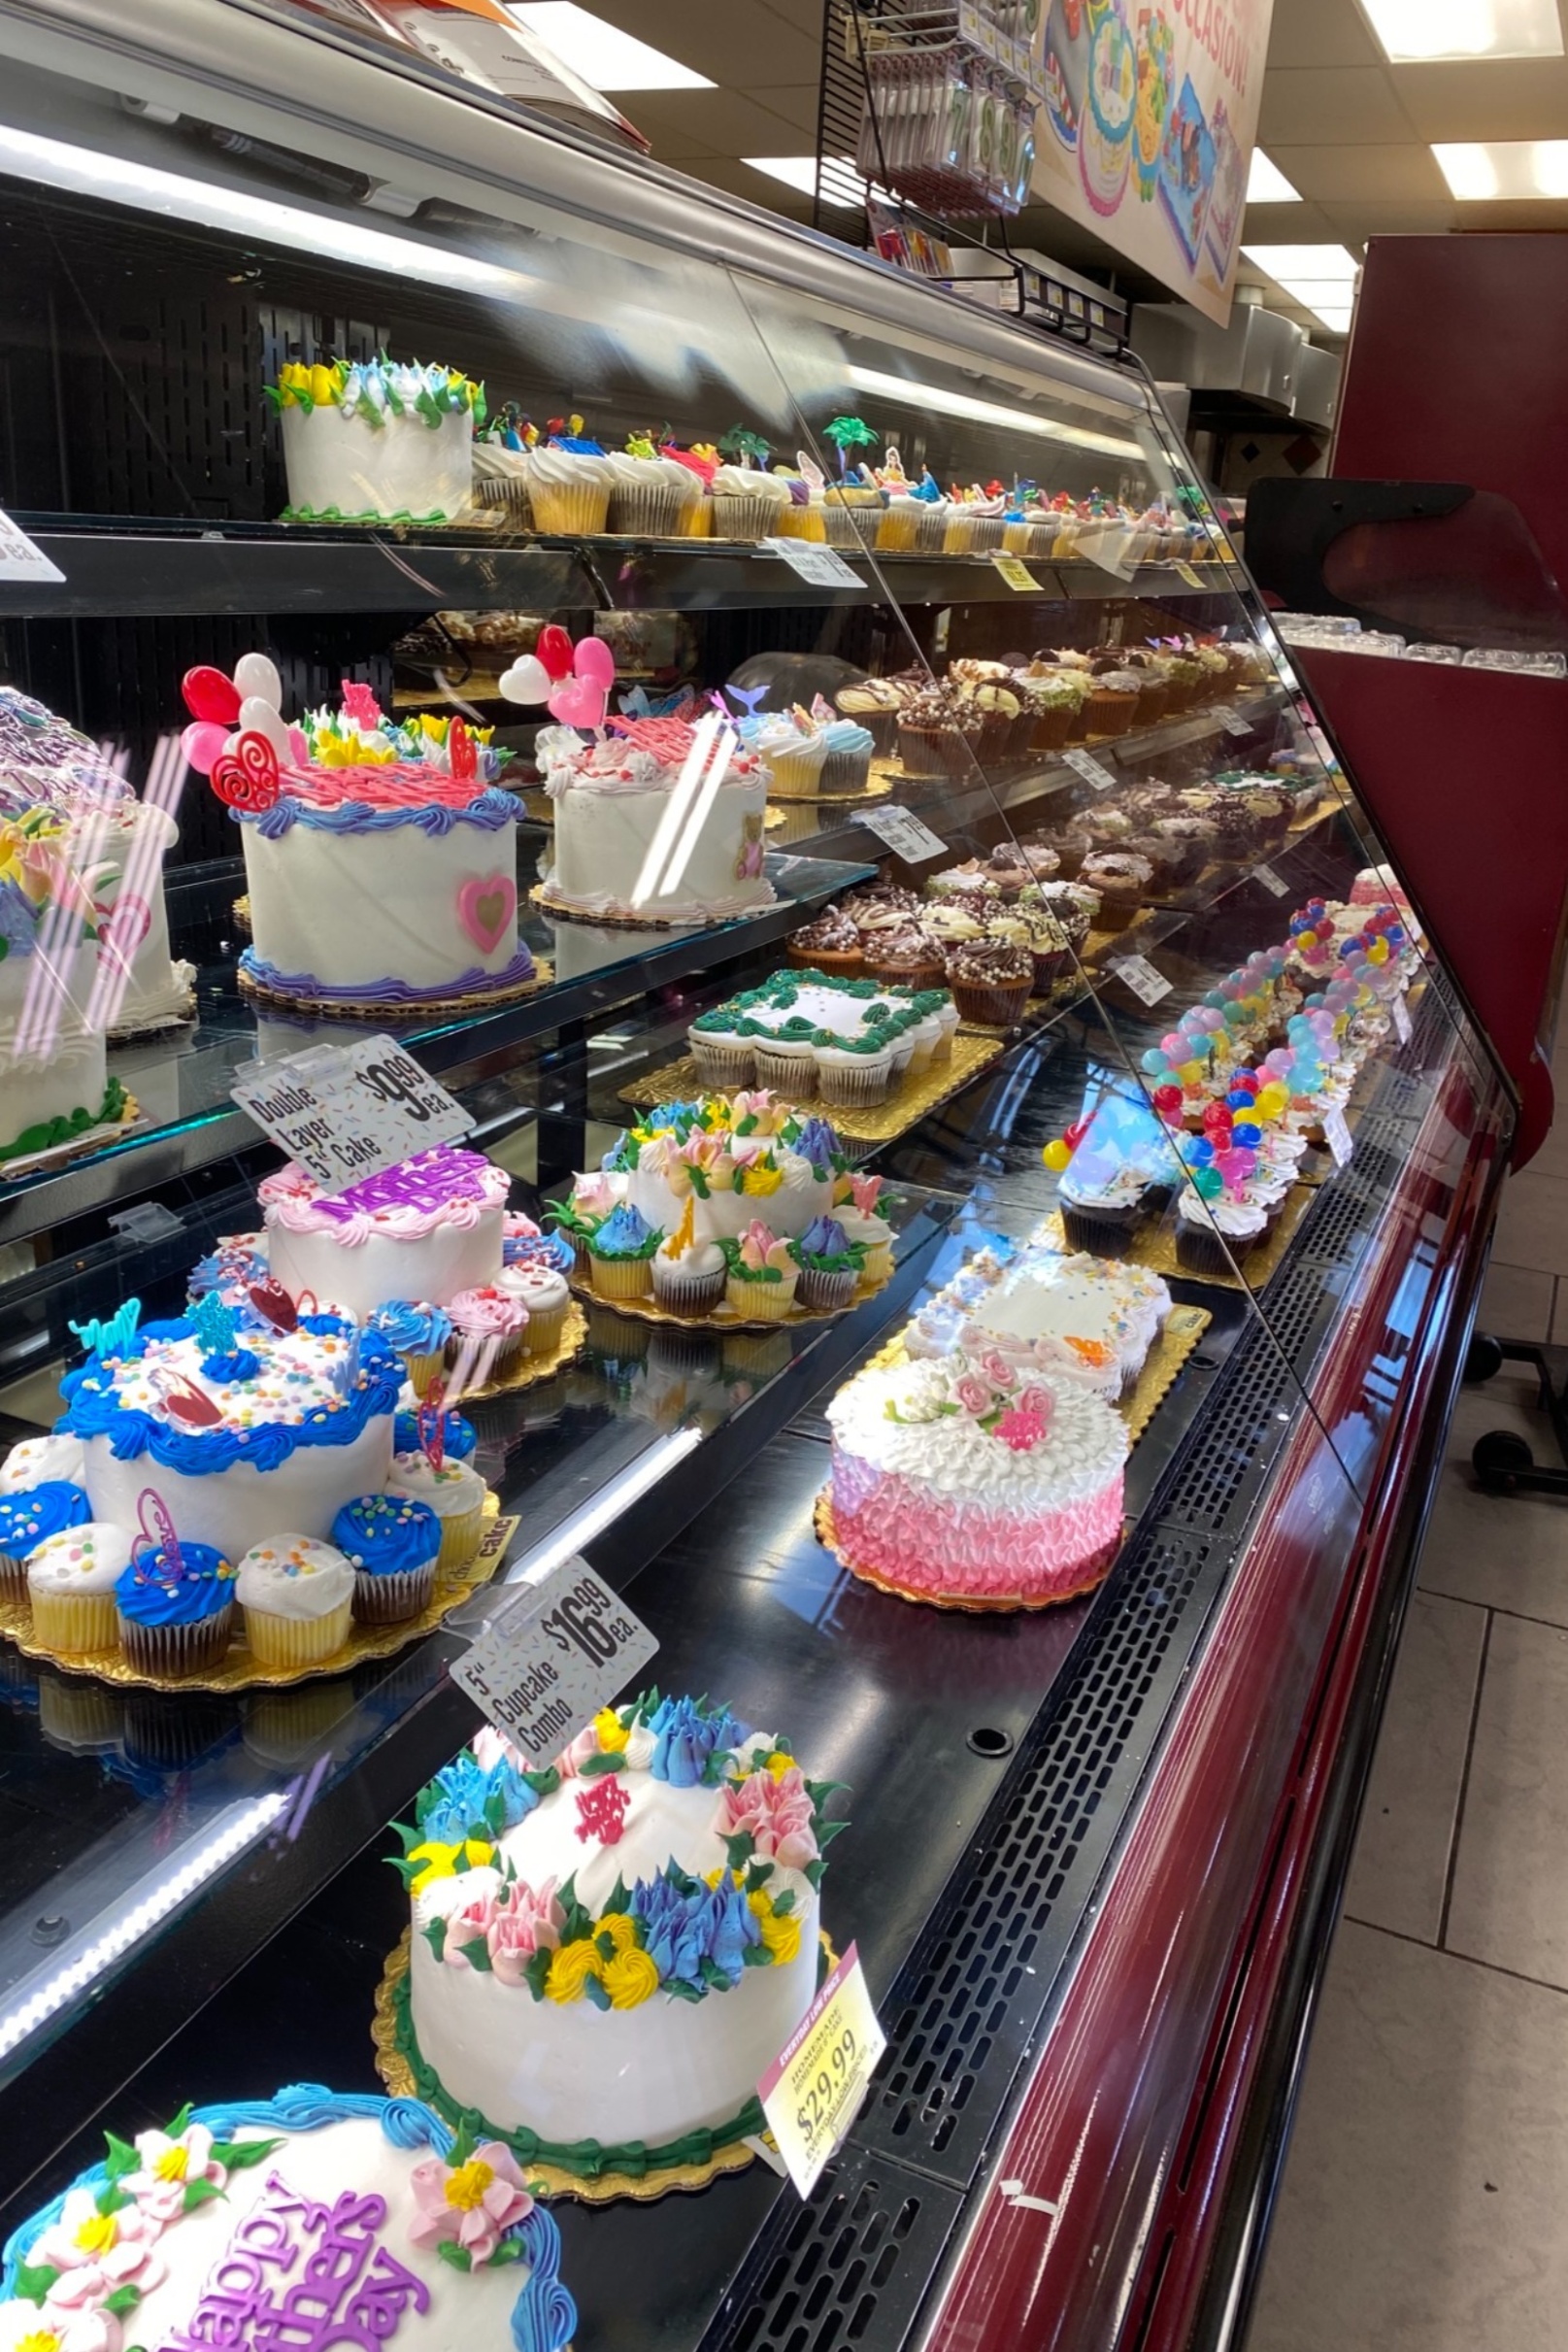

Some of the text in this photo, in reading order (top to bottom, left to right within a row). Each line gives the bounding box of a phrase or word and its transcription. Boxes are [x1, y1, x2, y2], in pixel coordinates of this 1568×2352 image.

[1173, 0, 1250, 99] CCASION!
[248, 1086, 317, 1124] Double
[421, 1095, 454, 1116] ea.
[275, 1118, 335, 1153] Layer
[330, 1136, 383, 1168] Cake
[479, 1519, 513, 1558] cake
[609, 1617, 639, 1643] ea.
[491, 1662, 559, 1725] Cupcake
[517, 1697, 574, 1753] Combo
[780, 1970, 842, 2068] EVERYDAY LOW PRICE
[790, 2004, 842, 2085] HOMEMADE
[796, 2028, 857, 2144] $29.99
